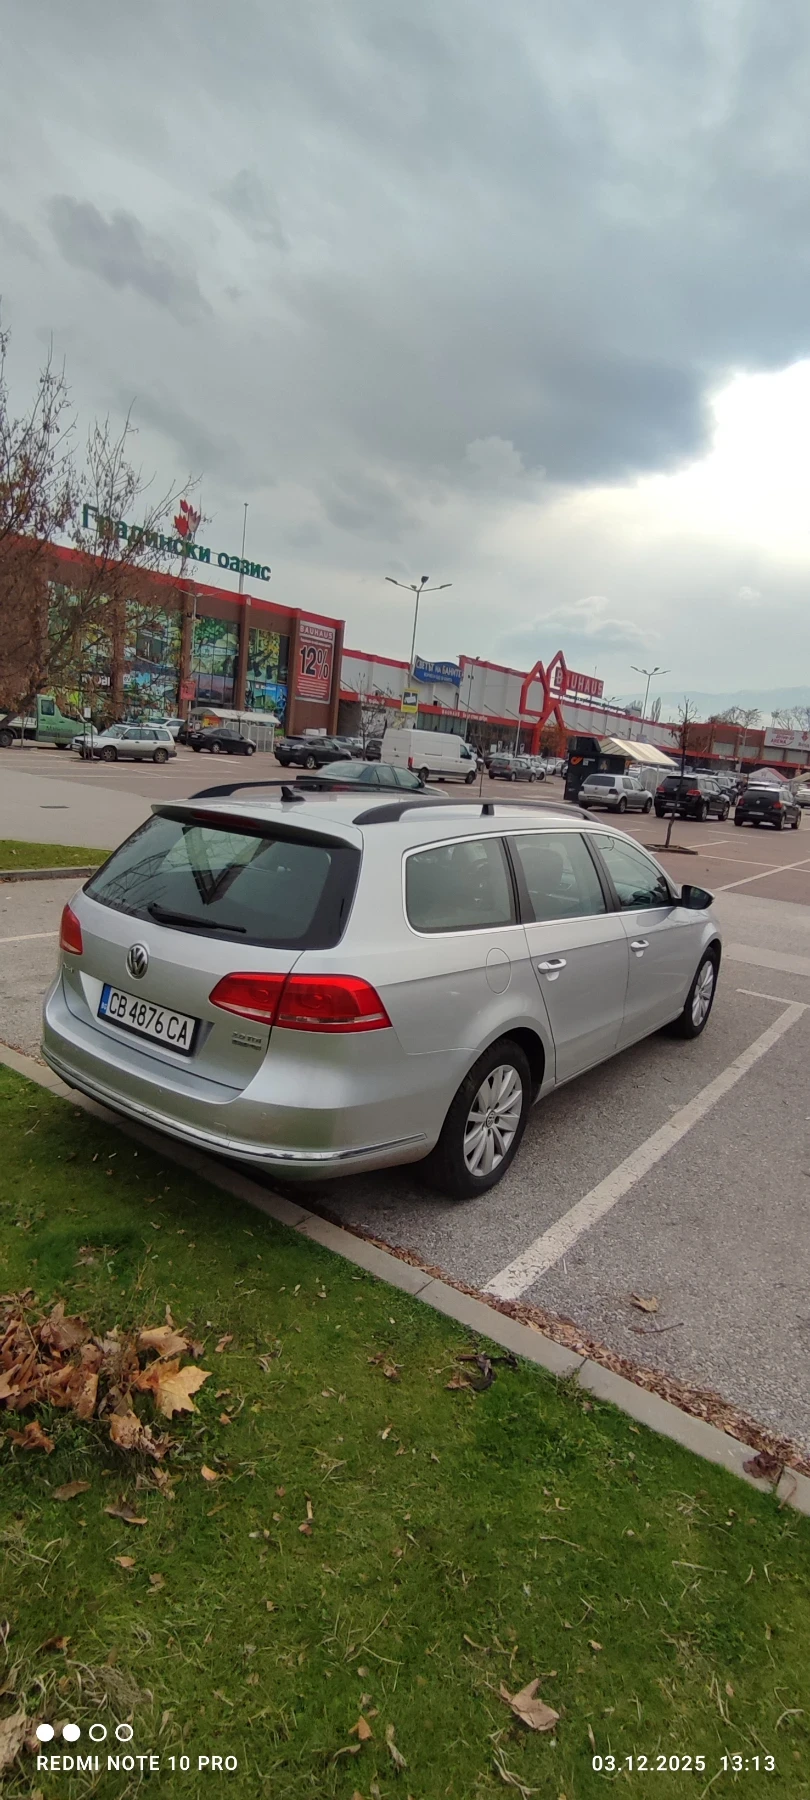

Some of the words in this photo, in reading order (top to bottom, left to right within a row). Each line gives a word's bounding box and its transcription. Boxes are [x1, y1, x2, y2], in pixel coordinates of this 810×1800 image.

[82, 503, 211, 564] Градински
[217, 552, 272, 582] оазис
[299, 625, 333, 640] BAUHAUS
[300, 645, 330, 680] 12%
[109, 993, 127, 1018] CB
[129, 1001, 164, 1034] 4876
[166, 1016, 188, 1045] CA
